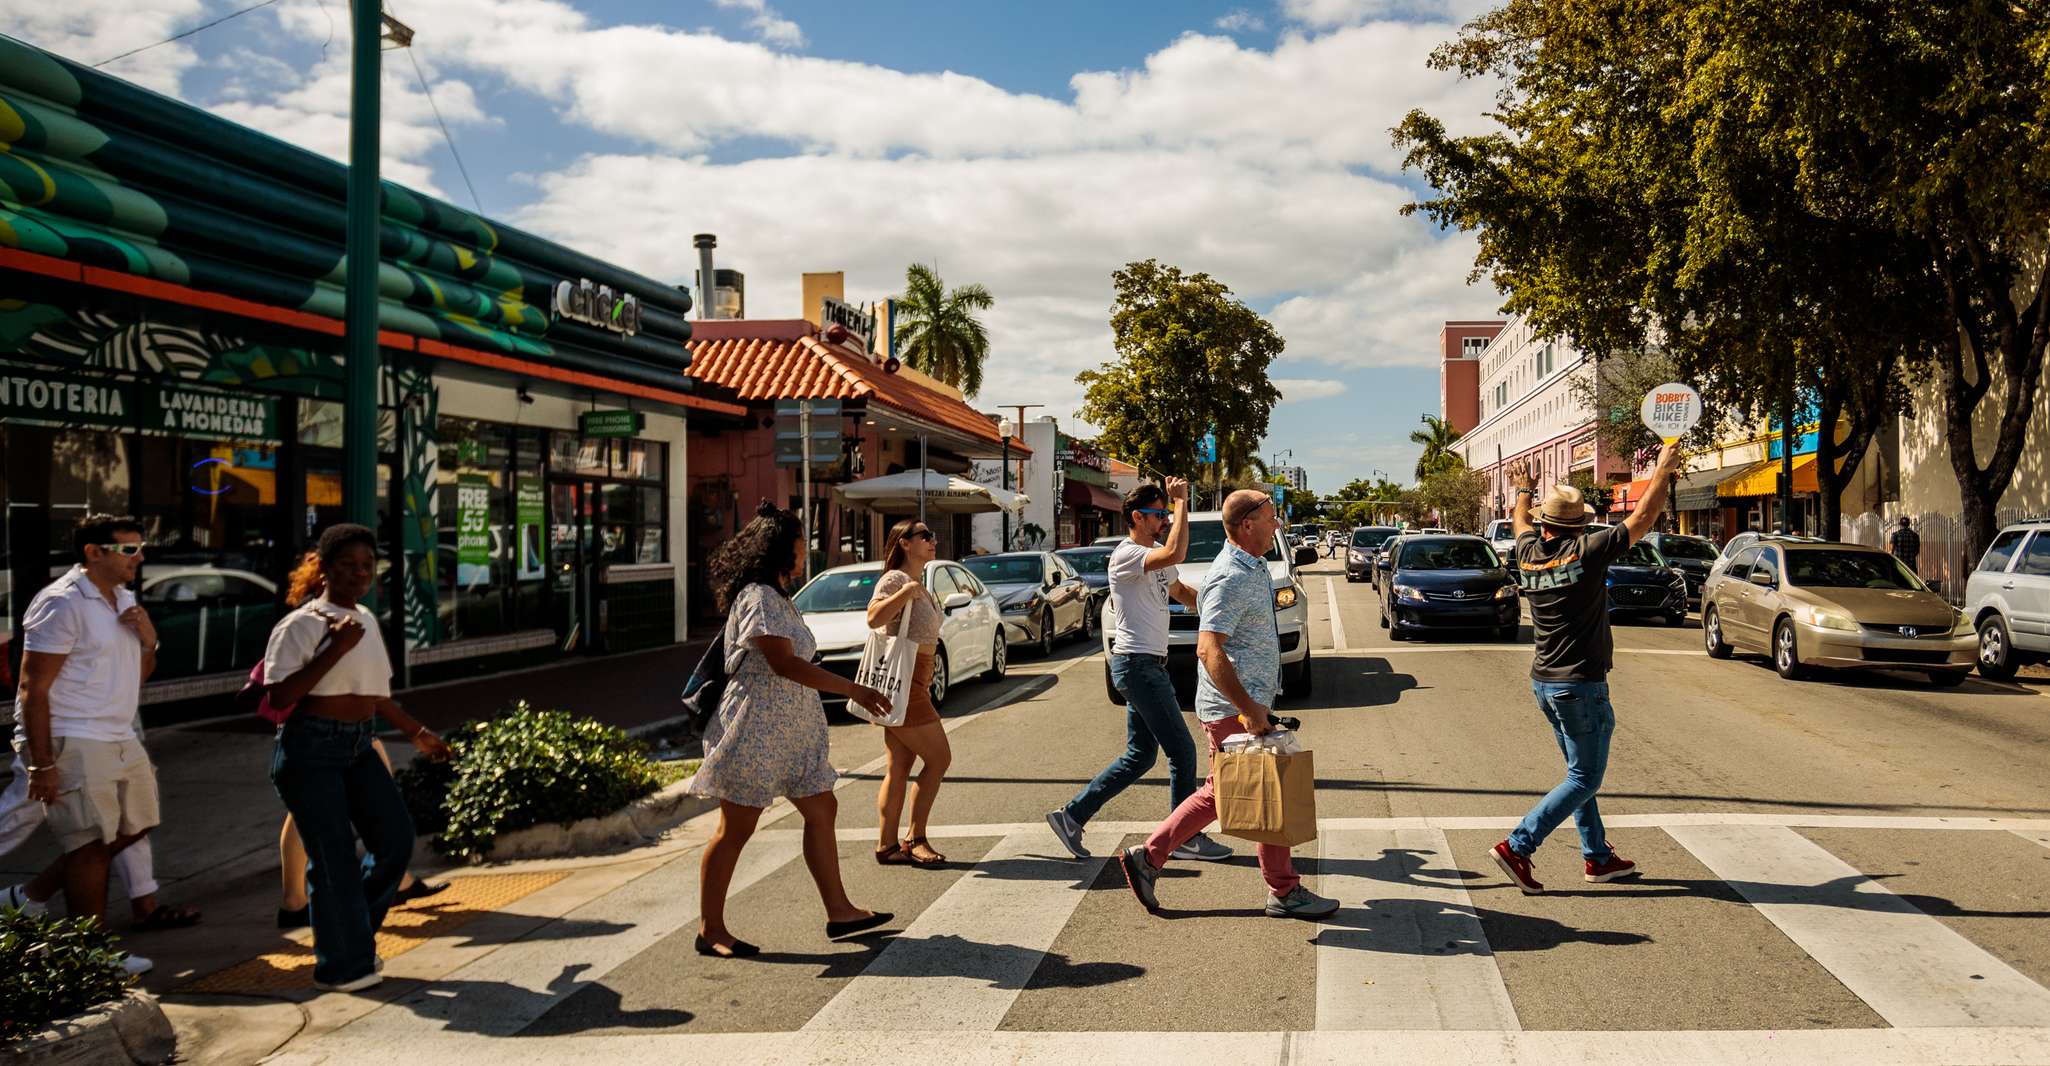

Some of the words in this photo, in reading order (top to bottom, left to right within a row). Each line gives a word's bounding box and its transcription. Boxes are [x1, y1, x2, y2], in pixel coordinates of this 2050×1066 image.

[159, 390, 266, 419] LAVANDERIA
[1655, 393, 1691, 404] BOBBY'S
[1655, 402, 1683, 413] BIKE
[163, 410, 176, 427] A
[182, 411, 264, 436] MONEDAS
[1653, 412, 1681, 422] HIKE
[457, 487, 489, 510] FREE
[461, 510, 485, 532] 5G
[458, 534, 488, 550] phone
[1518, 559, 1584, 590] STAFF
